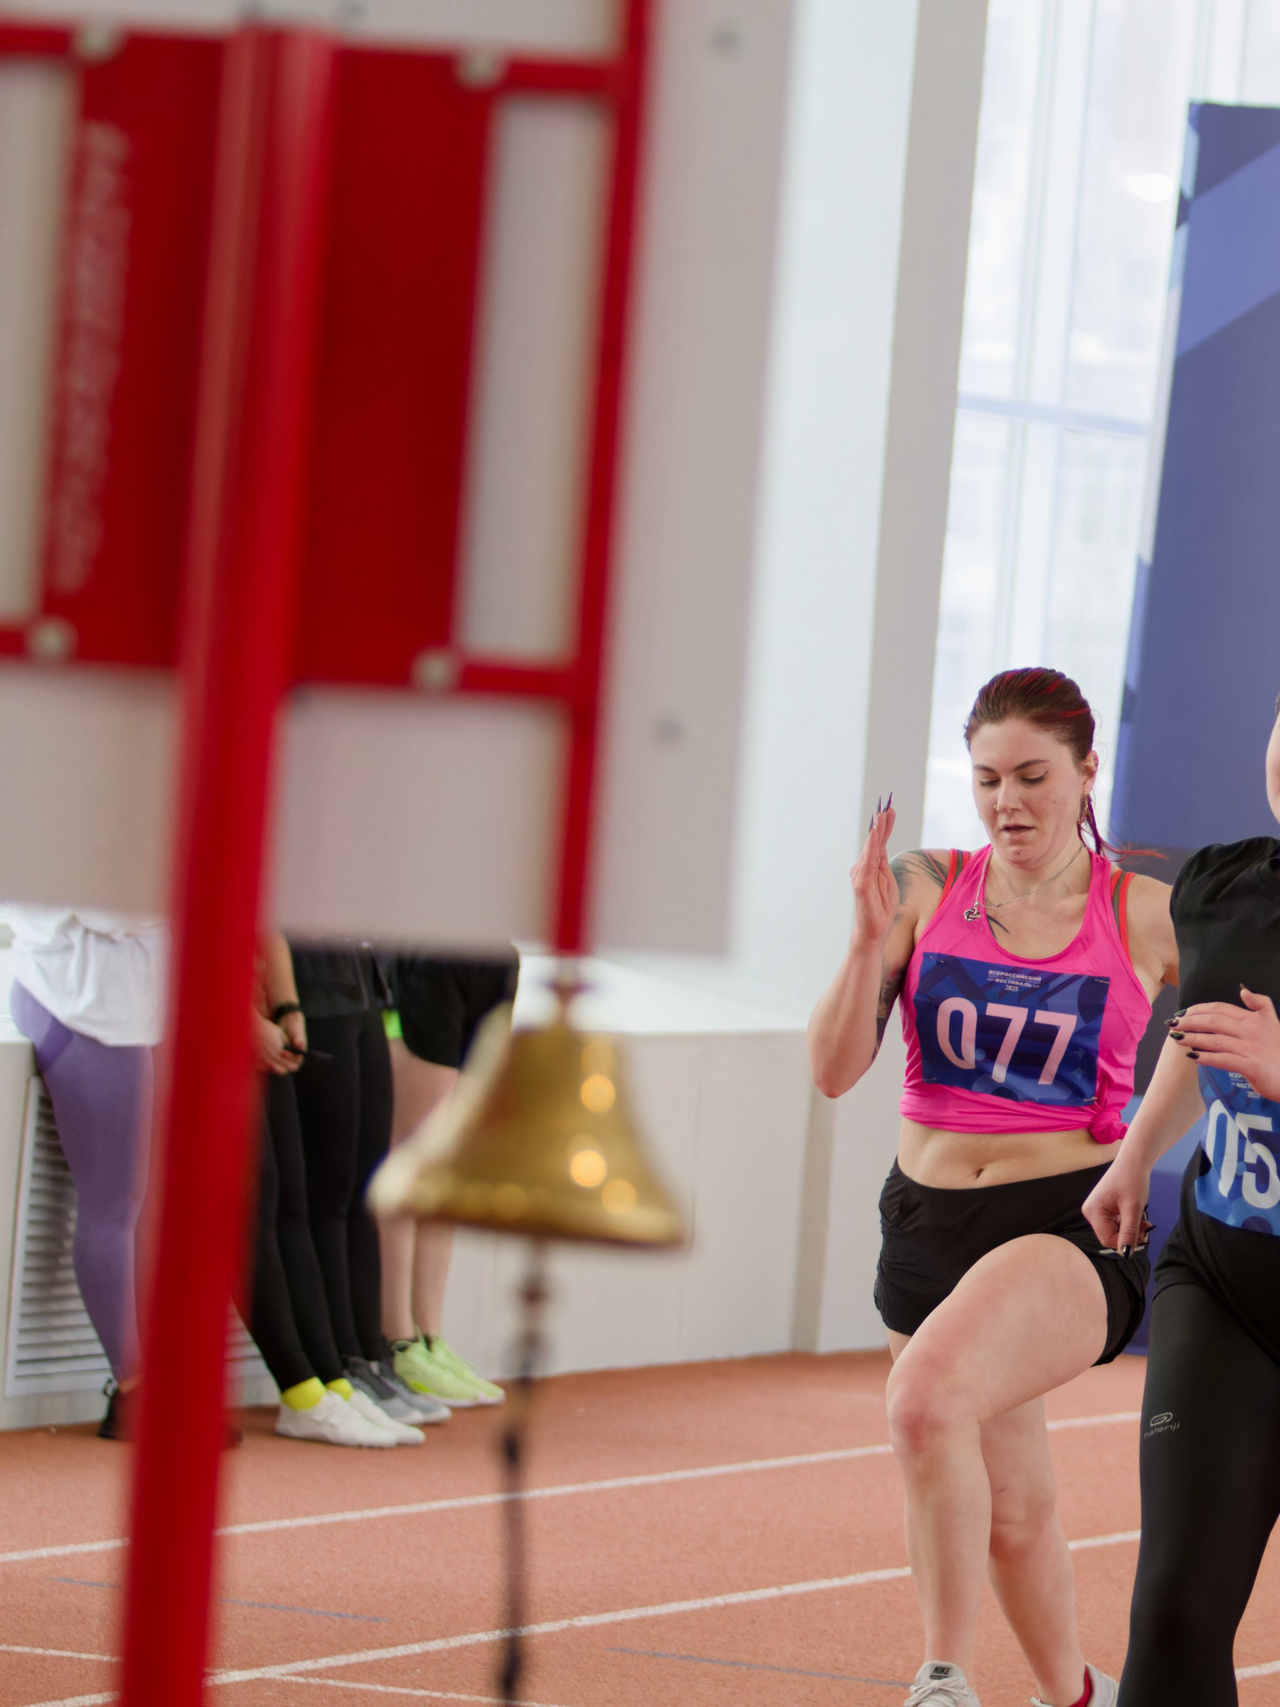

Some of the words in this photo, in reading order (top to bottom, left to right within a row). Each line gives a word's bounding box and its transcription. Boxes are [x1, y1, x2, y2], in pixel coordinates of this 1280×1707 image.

[988, 969, 1041, 982] ВСЕРОССИЙСКИЙ
[994, 978, 1032, 988] ФЕСТИВАЛЬ
[936, 996, 1078, 1086] 077
